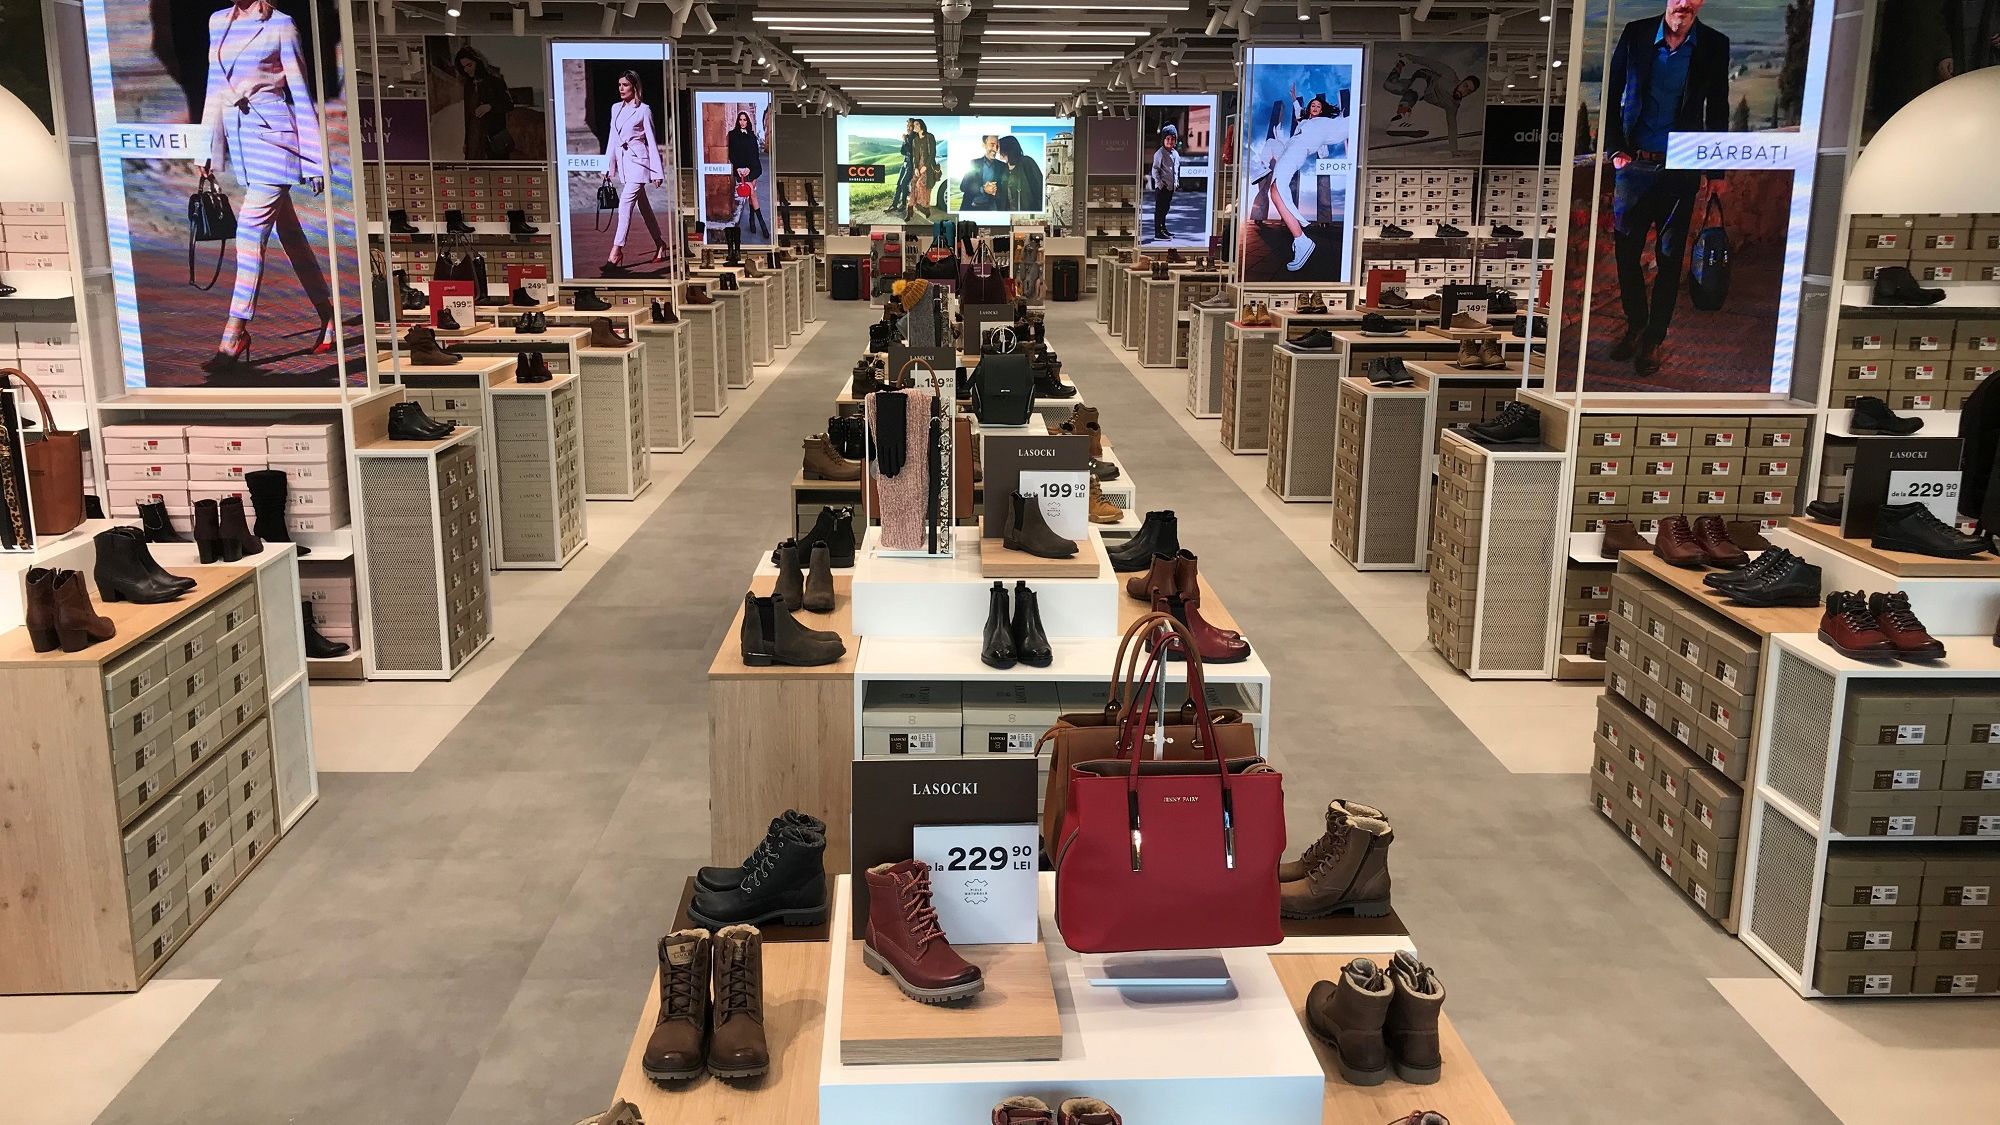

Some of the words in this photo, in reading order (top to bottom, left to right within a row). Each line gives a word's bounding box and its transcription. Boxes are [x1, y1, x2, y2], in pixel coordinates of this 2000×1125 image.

[121, 133, 188, 149] FEMEI
[1514, 128, 1564, 142] adia
[1696, 141, 1788, 164] BĂRBAȚI
[568, 158, 599, 167] FEMEI
[1319, 163, 1353, 171] SPORT
[848, 166, 875, 177] CCC
[1466, 304, 1481, 312] 149
[1018, 449, 1056, 457] LASOCKI
[1889, 451, 1928, 459] LASOCKI
[1040, 483, 1072, 498] 199
[1908, 482, 1944, 497] 229
[912, 782, 978, 795] LASOCKI
[935, 862, 944, 872] la
[948, 846, 1008, 871] 229
[1012, 845, 1032, 857] 90
[1013, 861, 1031, 870] LEI
